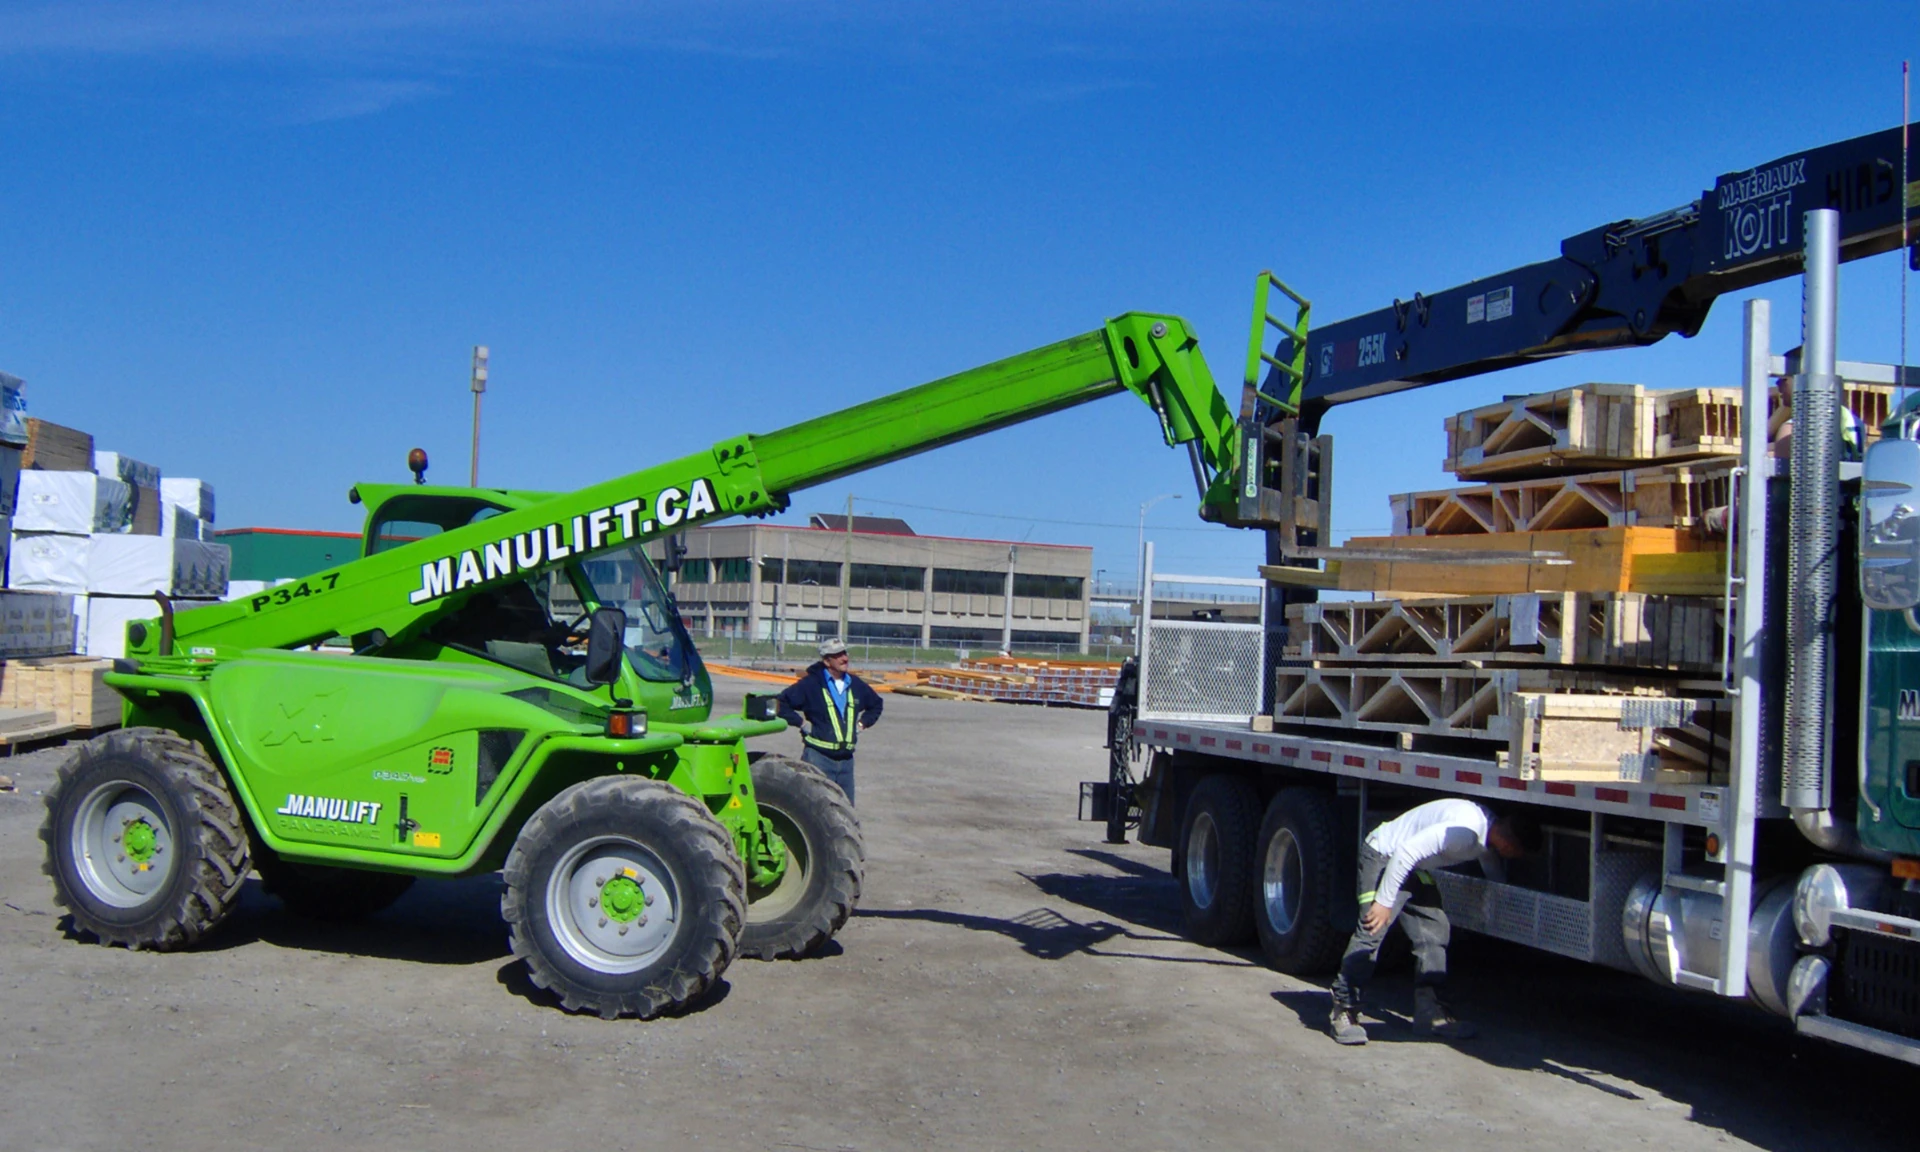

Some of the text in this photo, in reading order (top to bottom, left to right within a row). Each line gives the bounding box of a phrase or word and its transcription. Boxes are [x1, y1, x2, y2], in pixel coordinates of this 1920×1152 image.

[1718, 158, 1806, 209] MATÉRIAUX
[1724, 191, 1792, 260] KOTT
[1358, 332, 1387, 367] 255K
[409, 477, 718, 606] MANULIFT.CA
[251, 571, 342, 613] P34.7
[277, 793, 383, 825] MANULIFT
